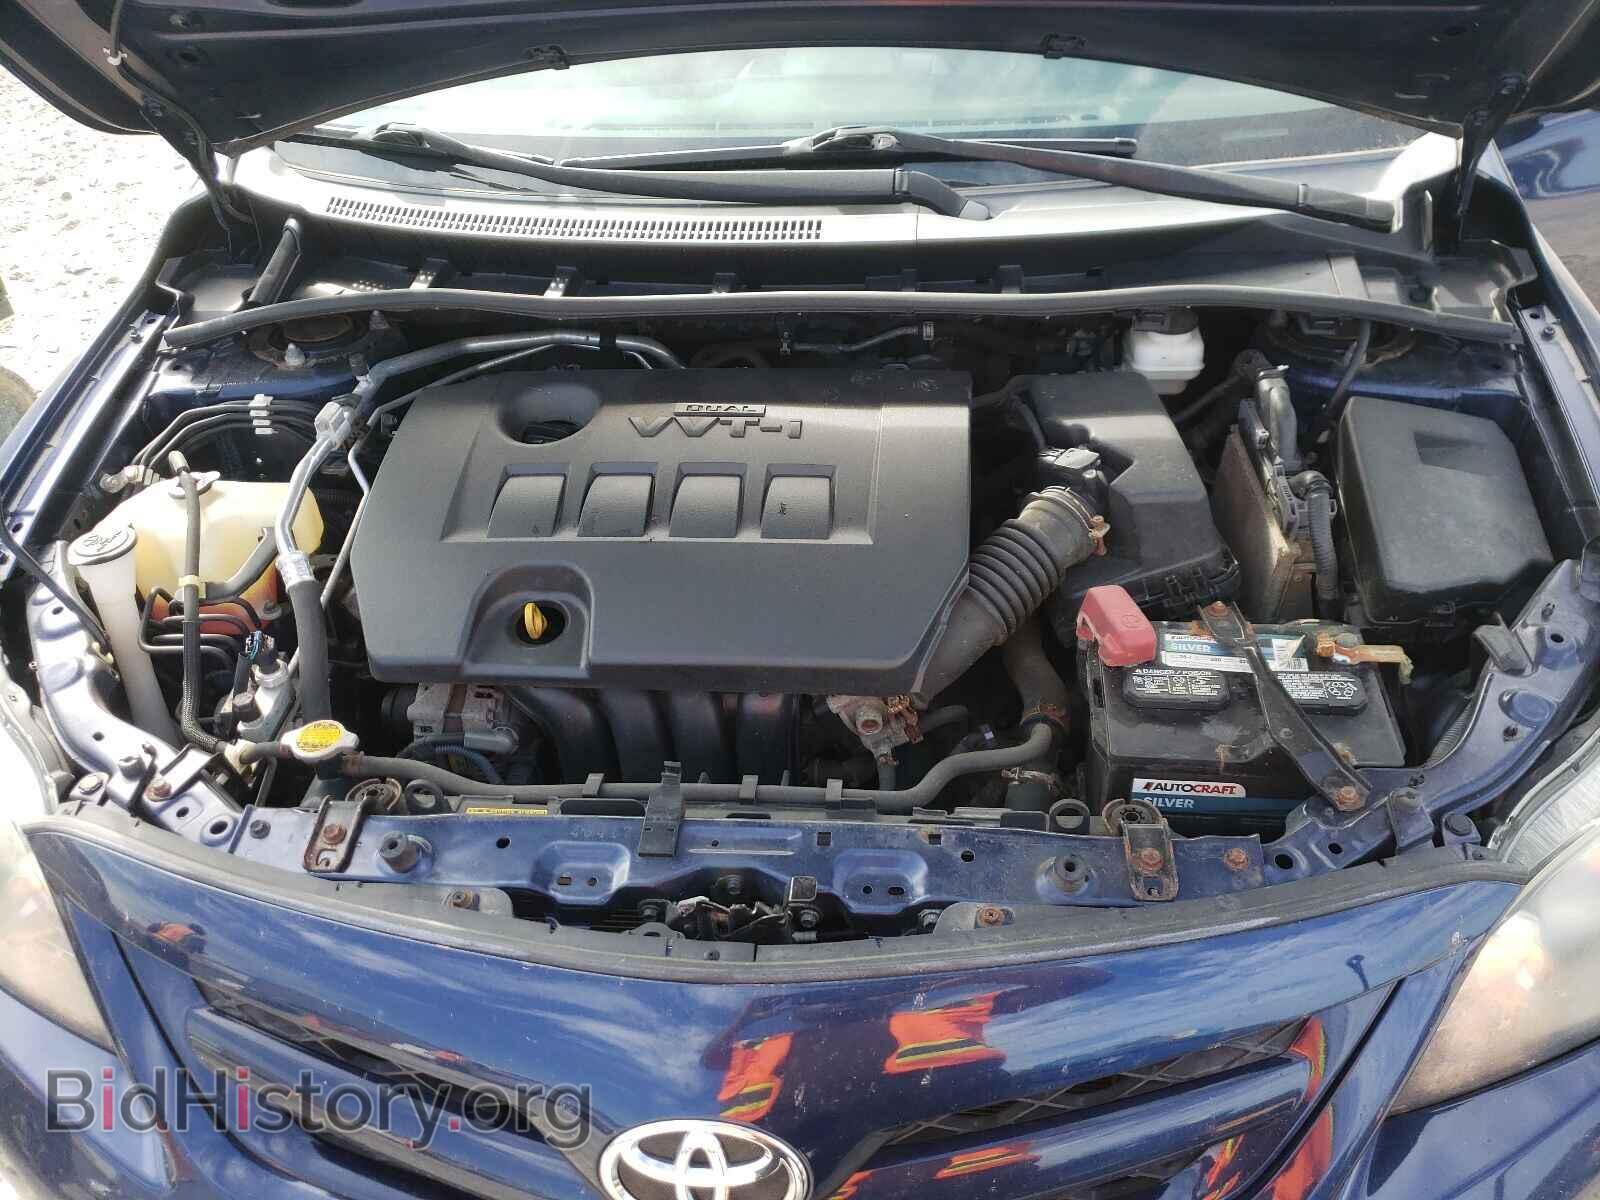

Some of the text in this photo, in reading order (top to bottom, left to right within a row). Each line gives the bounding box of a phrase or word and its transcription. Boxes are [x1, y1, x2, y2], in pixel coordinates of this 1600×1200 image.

[686, 404, 758, 413] DUAL
[1171, 642, 1210, 652] SILVER
[1152, 781, 1237, 795] AUTOCRAFT
